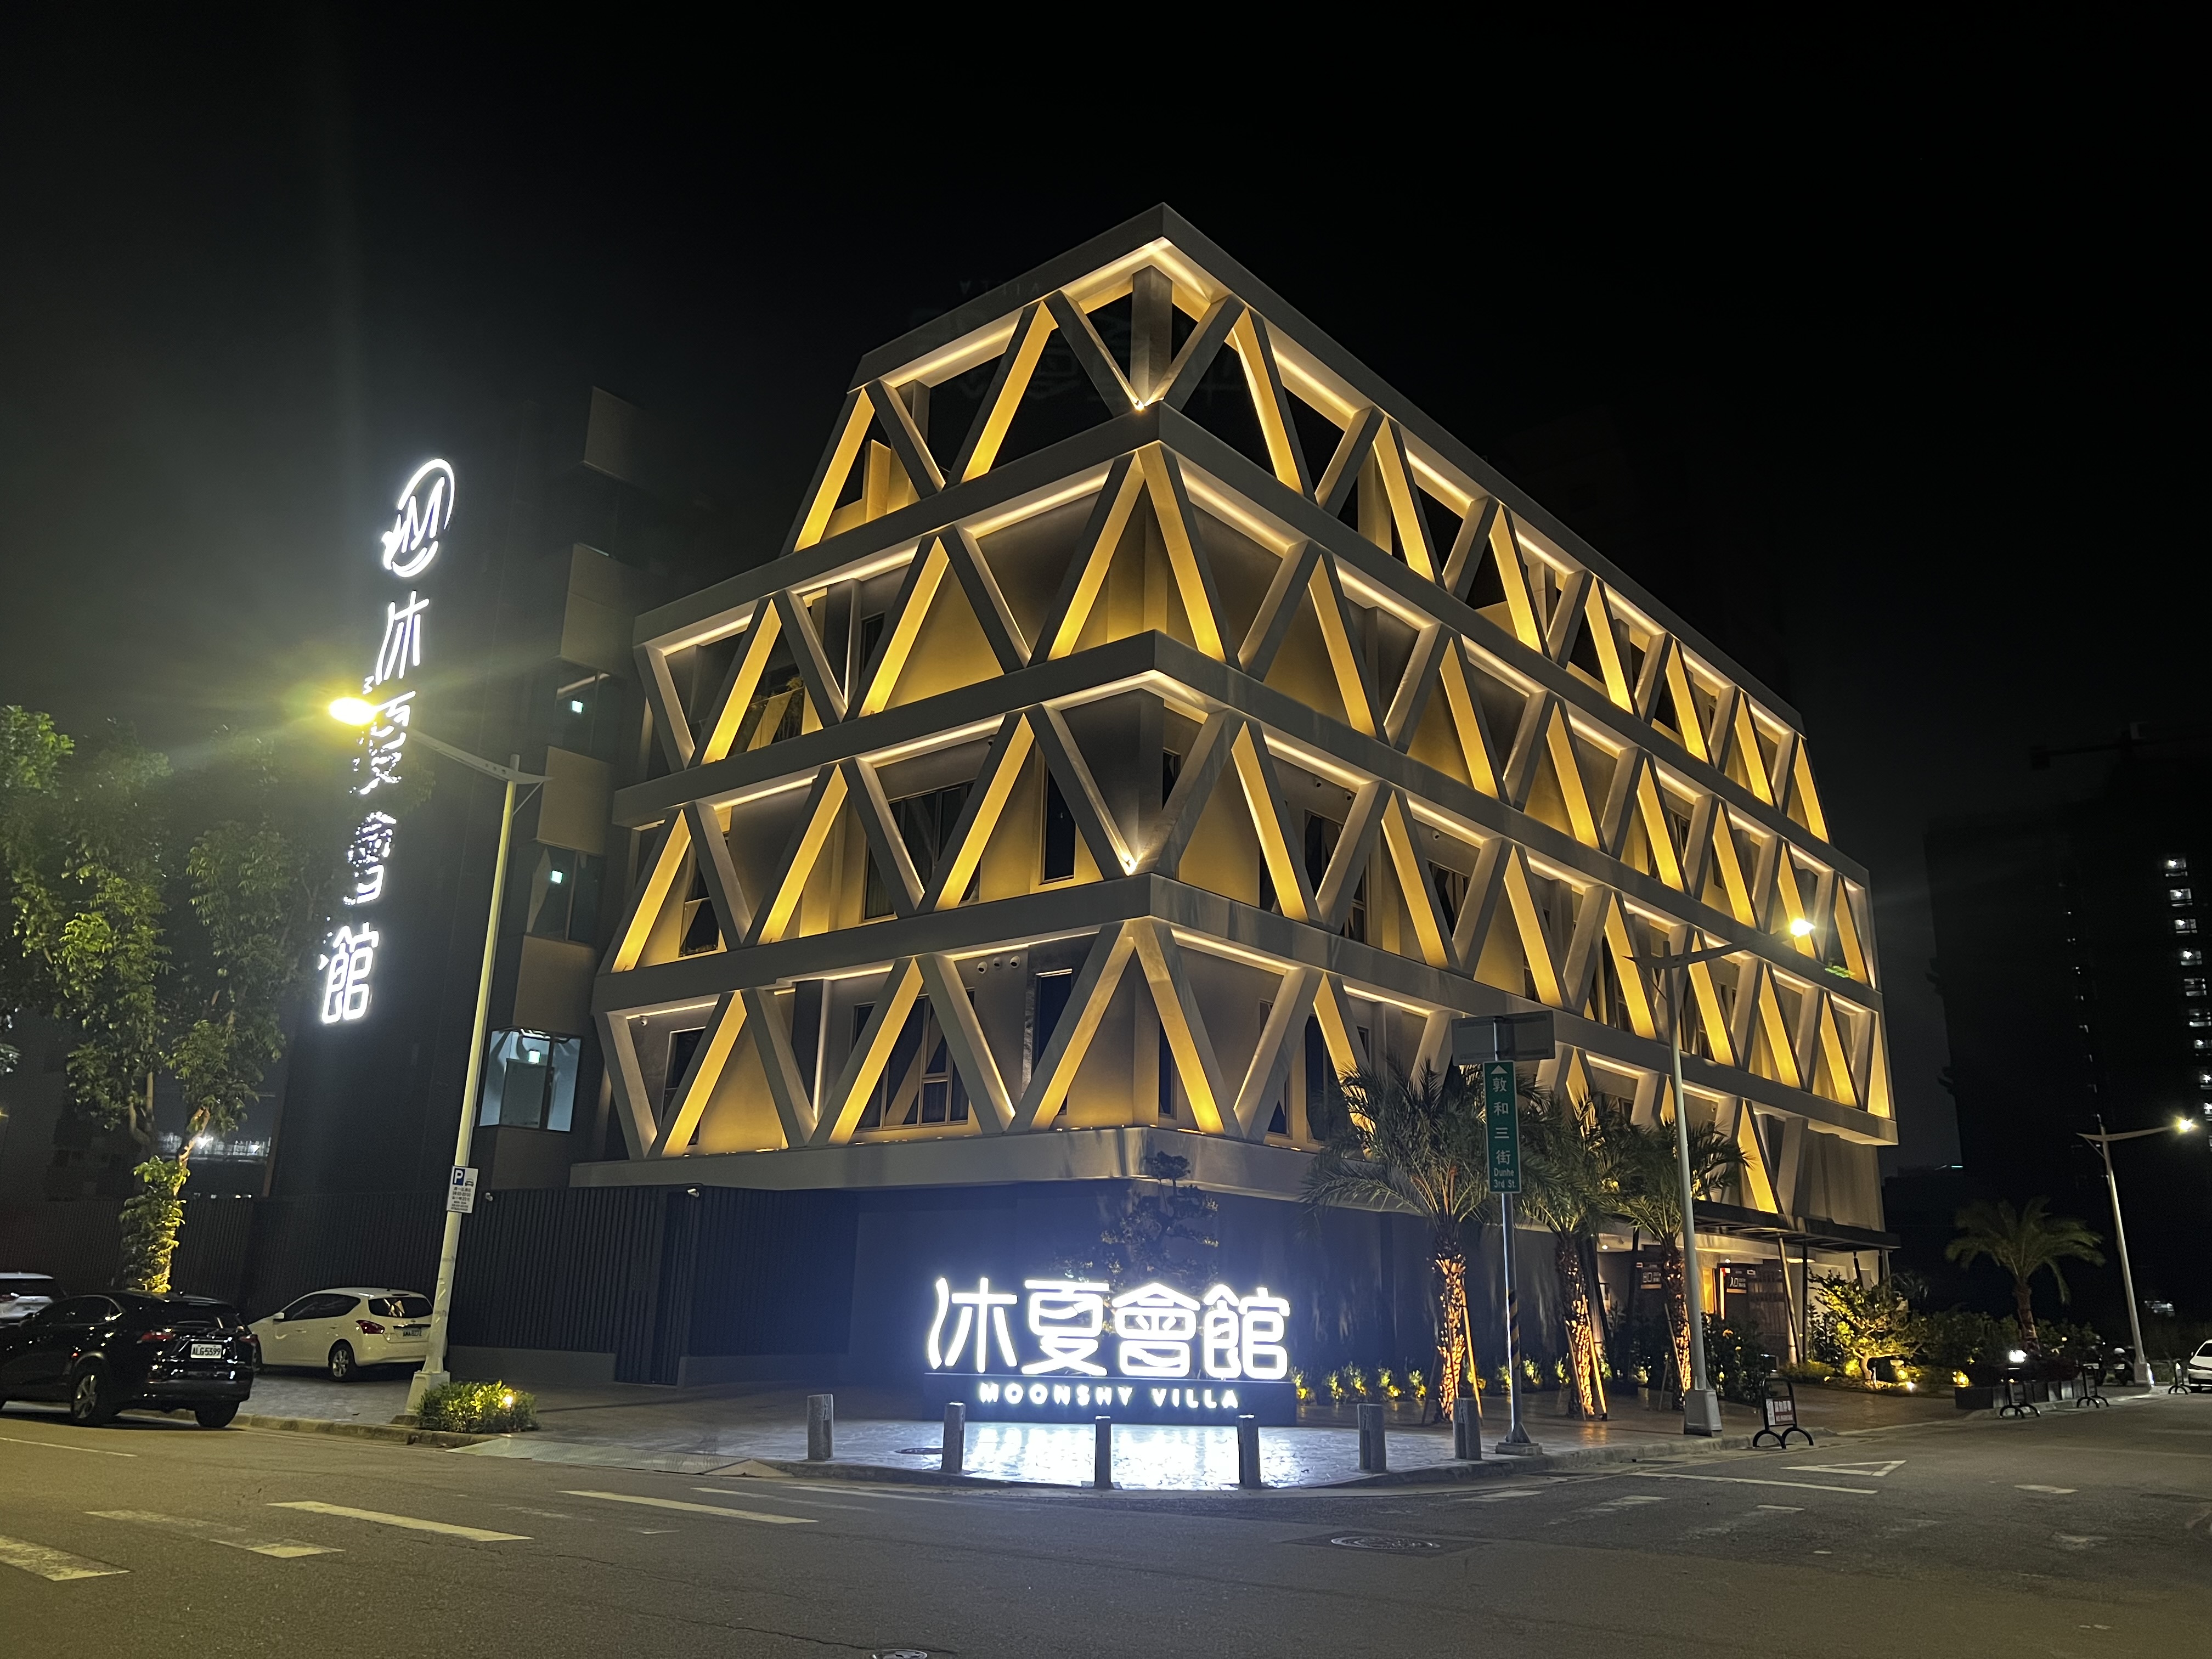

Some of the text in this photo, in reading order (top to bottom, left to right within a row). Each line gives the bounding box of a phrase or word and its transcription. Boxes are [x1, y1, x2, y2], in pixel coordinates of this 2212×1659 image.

[1492, 1077, 1511, 1165] 敦和三街
[454, 1169, 464, 1184] P
[1493, 1167, 1514, 1177] Dunhe
[1494, 1179, 1505, 1188] 3rd
[927, 1277, 1291, 1380] 沐夏會館
[979, 1382, 1239, 1409] MOONSHY VILLA
